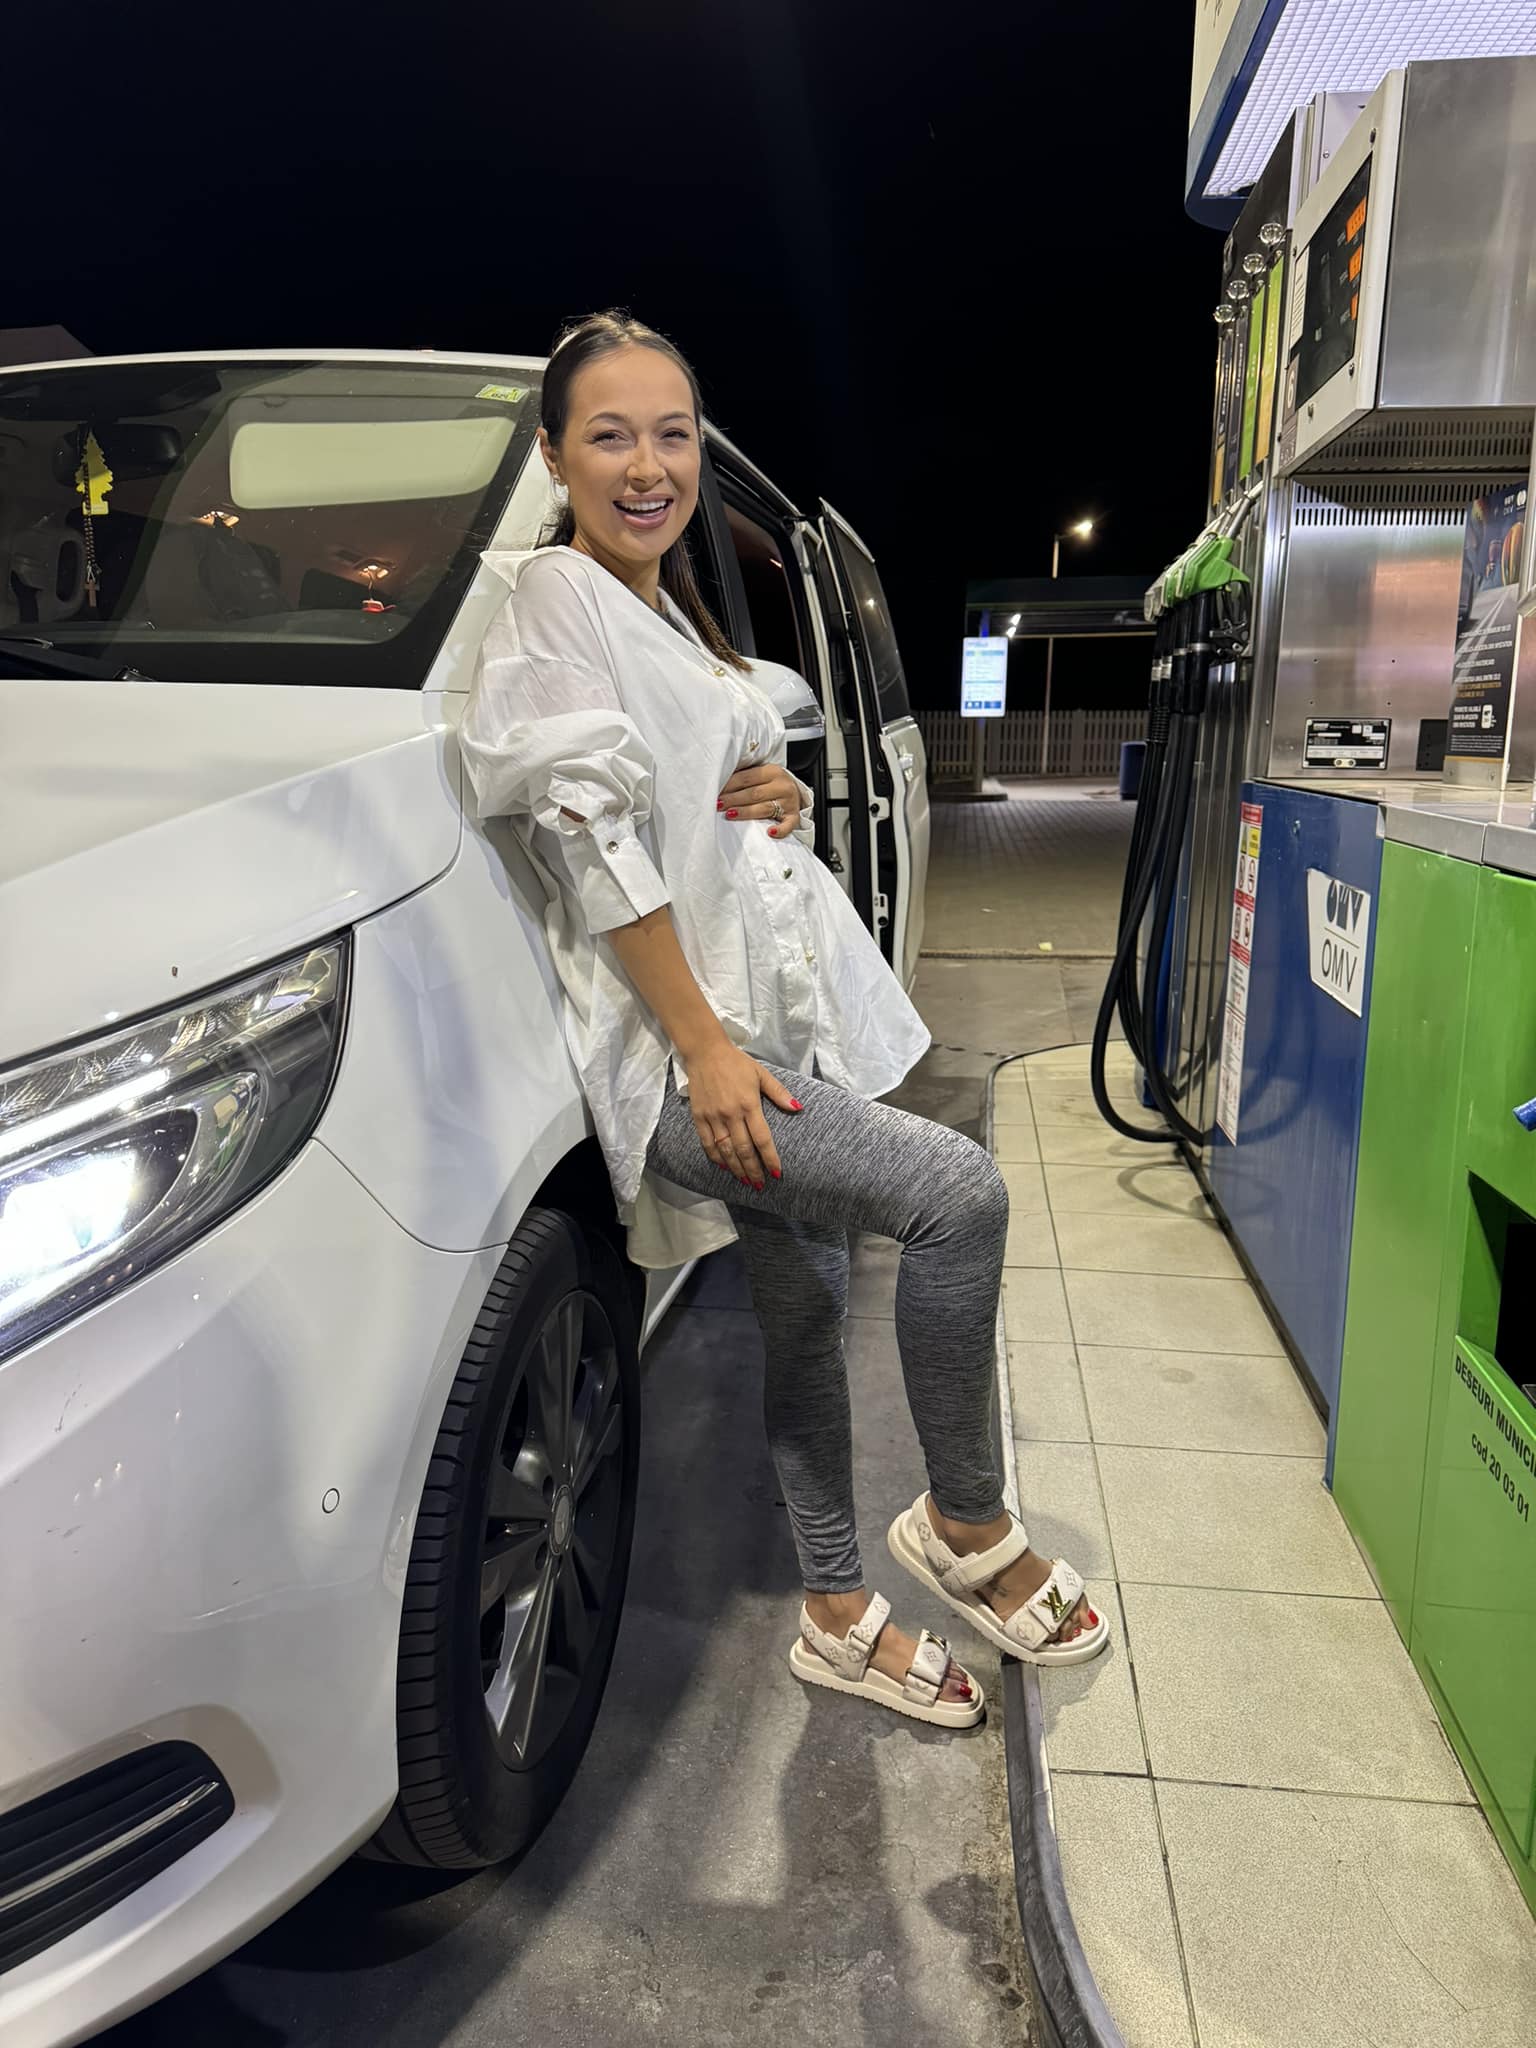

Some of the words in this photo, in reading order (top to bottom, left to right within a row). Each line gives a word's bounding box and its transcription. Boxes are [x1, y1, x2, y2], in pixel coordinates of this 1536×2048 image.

[1287, 369, 1295, 409] 6
[1326, 879, 1364, 934] OMV
[1321, 937, 1358, 993] OMV
[1455, 1354, 1495, 1419] DESEURI
[1495, 1407, 1536, 1479] MUNICI
[1471, 1433, 1489, 1465] cod
[1488, 1453, 1501, 1482] 20
[1503, 1472, 1515, 1502] 03
[1517, 1492, 1530, 1523] 01
